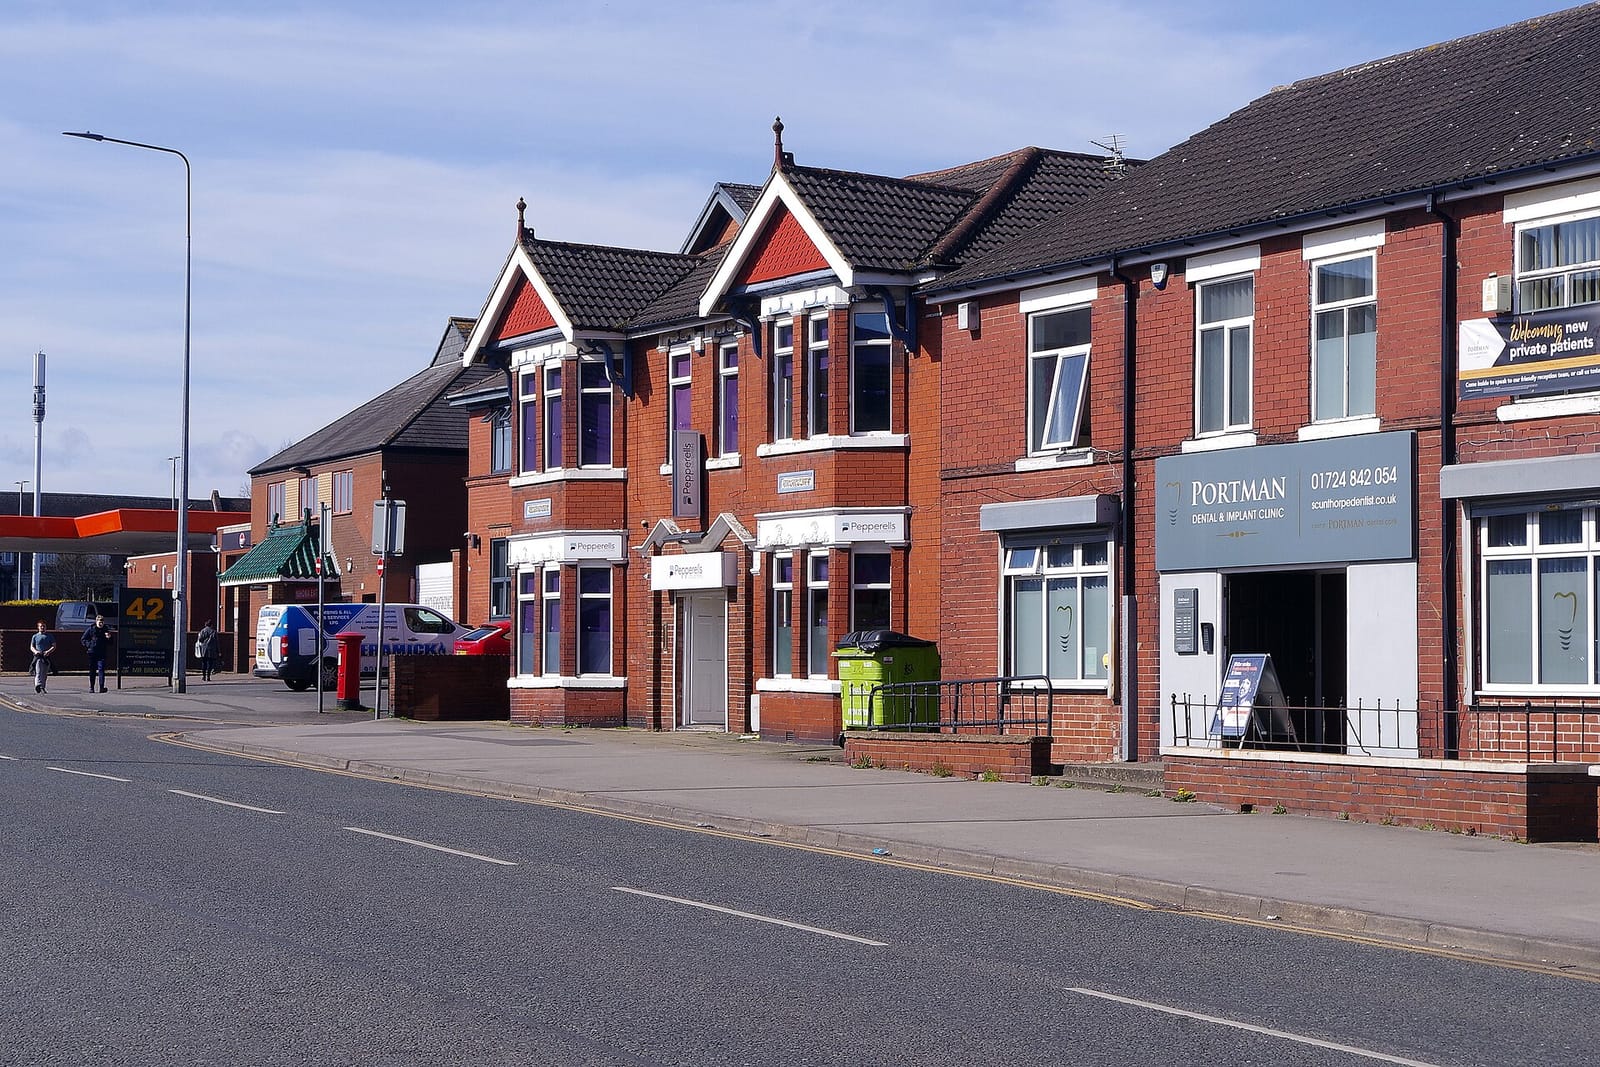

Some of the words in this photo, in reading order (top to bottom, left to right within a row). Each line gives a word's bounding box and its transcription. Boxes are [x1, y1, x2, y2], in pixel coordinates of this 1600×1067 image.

[1510, 317, 1562, 345] Welcoming
[1565, 321, 1588, 334] new
[1510, 342, 1547, 361] private
[1550, 336, 1594, 356] patients
[1521, 374, 1537, 382] friendly
[1538, 372, 1558, 381] reception
[683, 442, 694, 494] Pepperells
[1312, 470, 1346, 490] 01724
[1350, 468, 1372, 486] 842
[1374, 466, 1397, 484] 054
[1192, 476, 1286, 506] PORTMAN
[1312, 494, 1396, 510] scunthorpedentist.co.uk
[1192, 514, 1217, 524] DENTAL
[1218, 512, 1224, 522] &
[1226, 510, 1256, 521] IMPLANT
[1258, 508, 1284, 519] CLINIC
[1328, 520, 1364, 528] PORTMAN
[851, 522, 896, 533] Pepperells
[578, 542, 616, 552] Pepperells
[674, 564, 702, 579] Pepperells
[126, 597, 164, 620] 42
